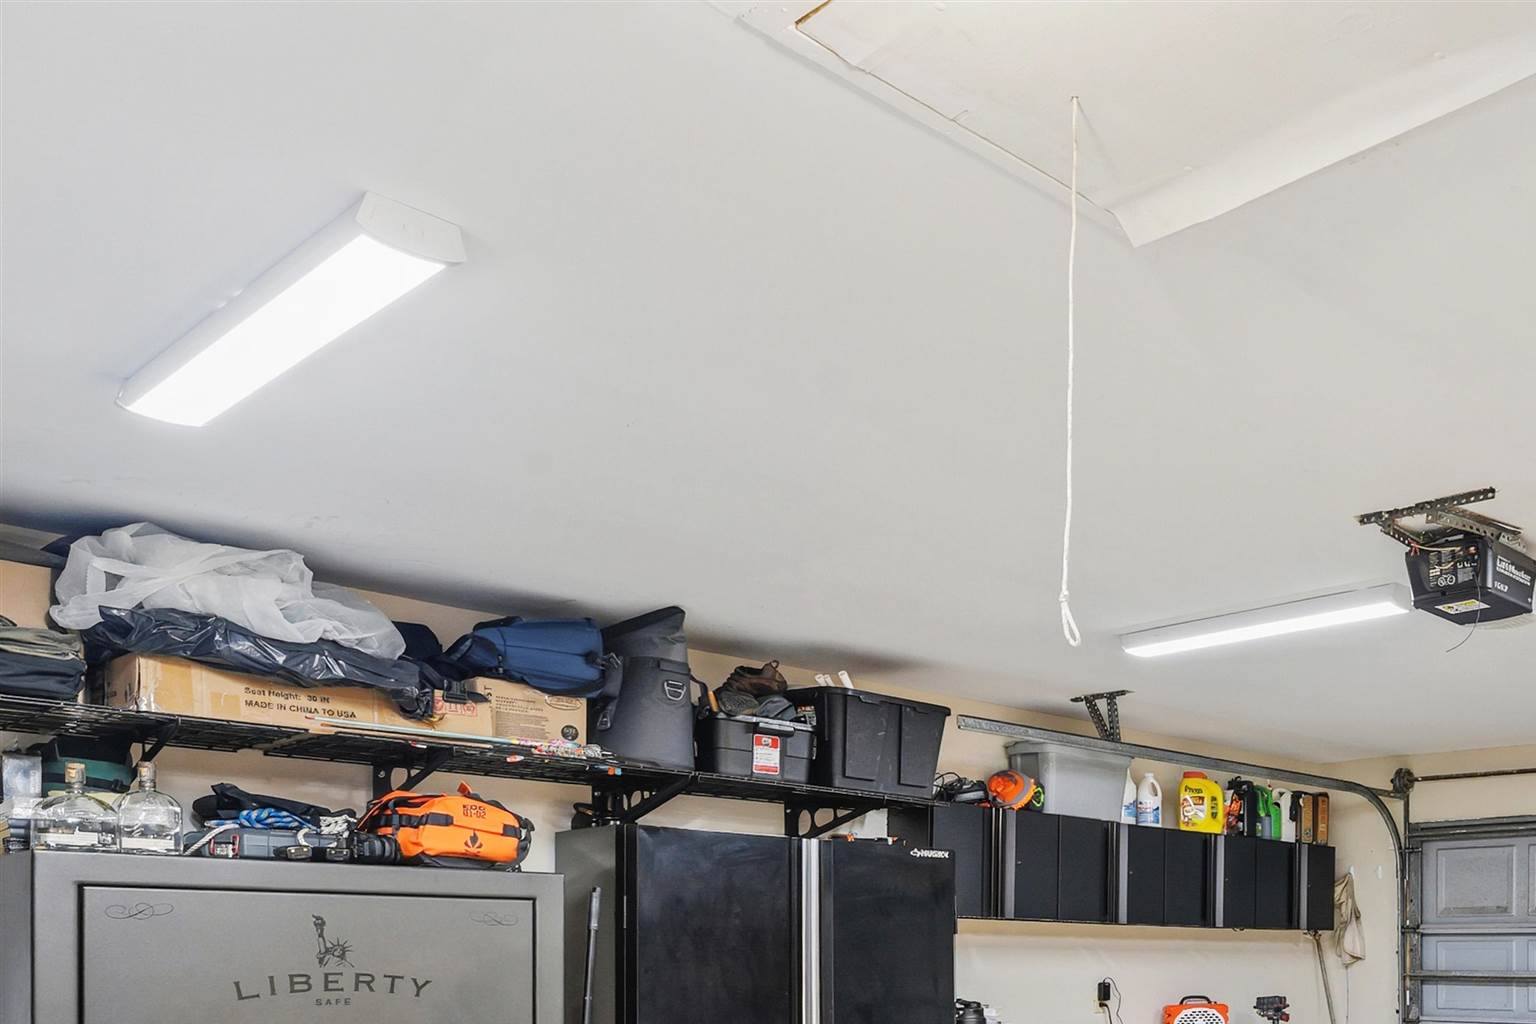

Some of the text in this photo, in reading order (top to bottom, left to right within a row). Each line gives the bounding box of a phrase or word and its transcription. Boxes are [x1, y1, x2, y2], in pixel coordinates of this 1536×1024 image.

[243, 686, 266, 697] Seat
[267, 689, 302, 701] Height:
[244, 699, 357, 719] MADE IN CHINA TO USA
[232, 971, 433, 1001] LIBERTY
[314, 998, 353, 1006] SAFE
